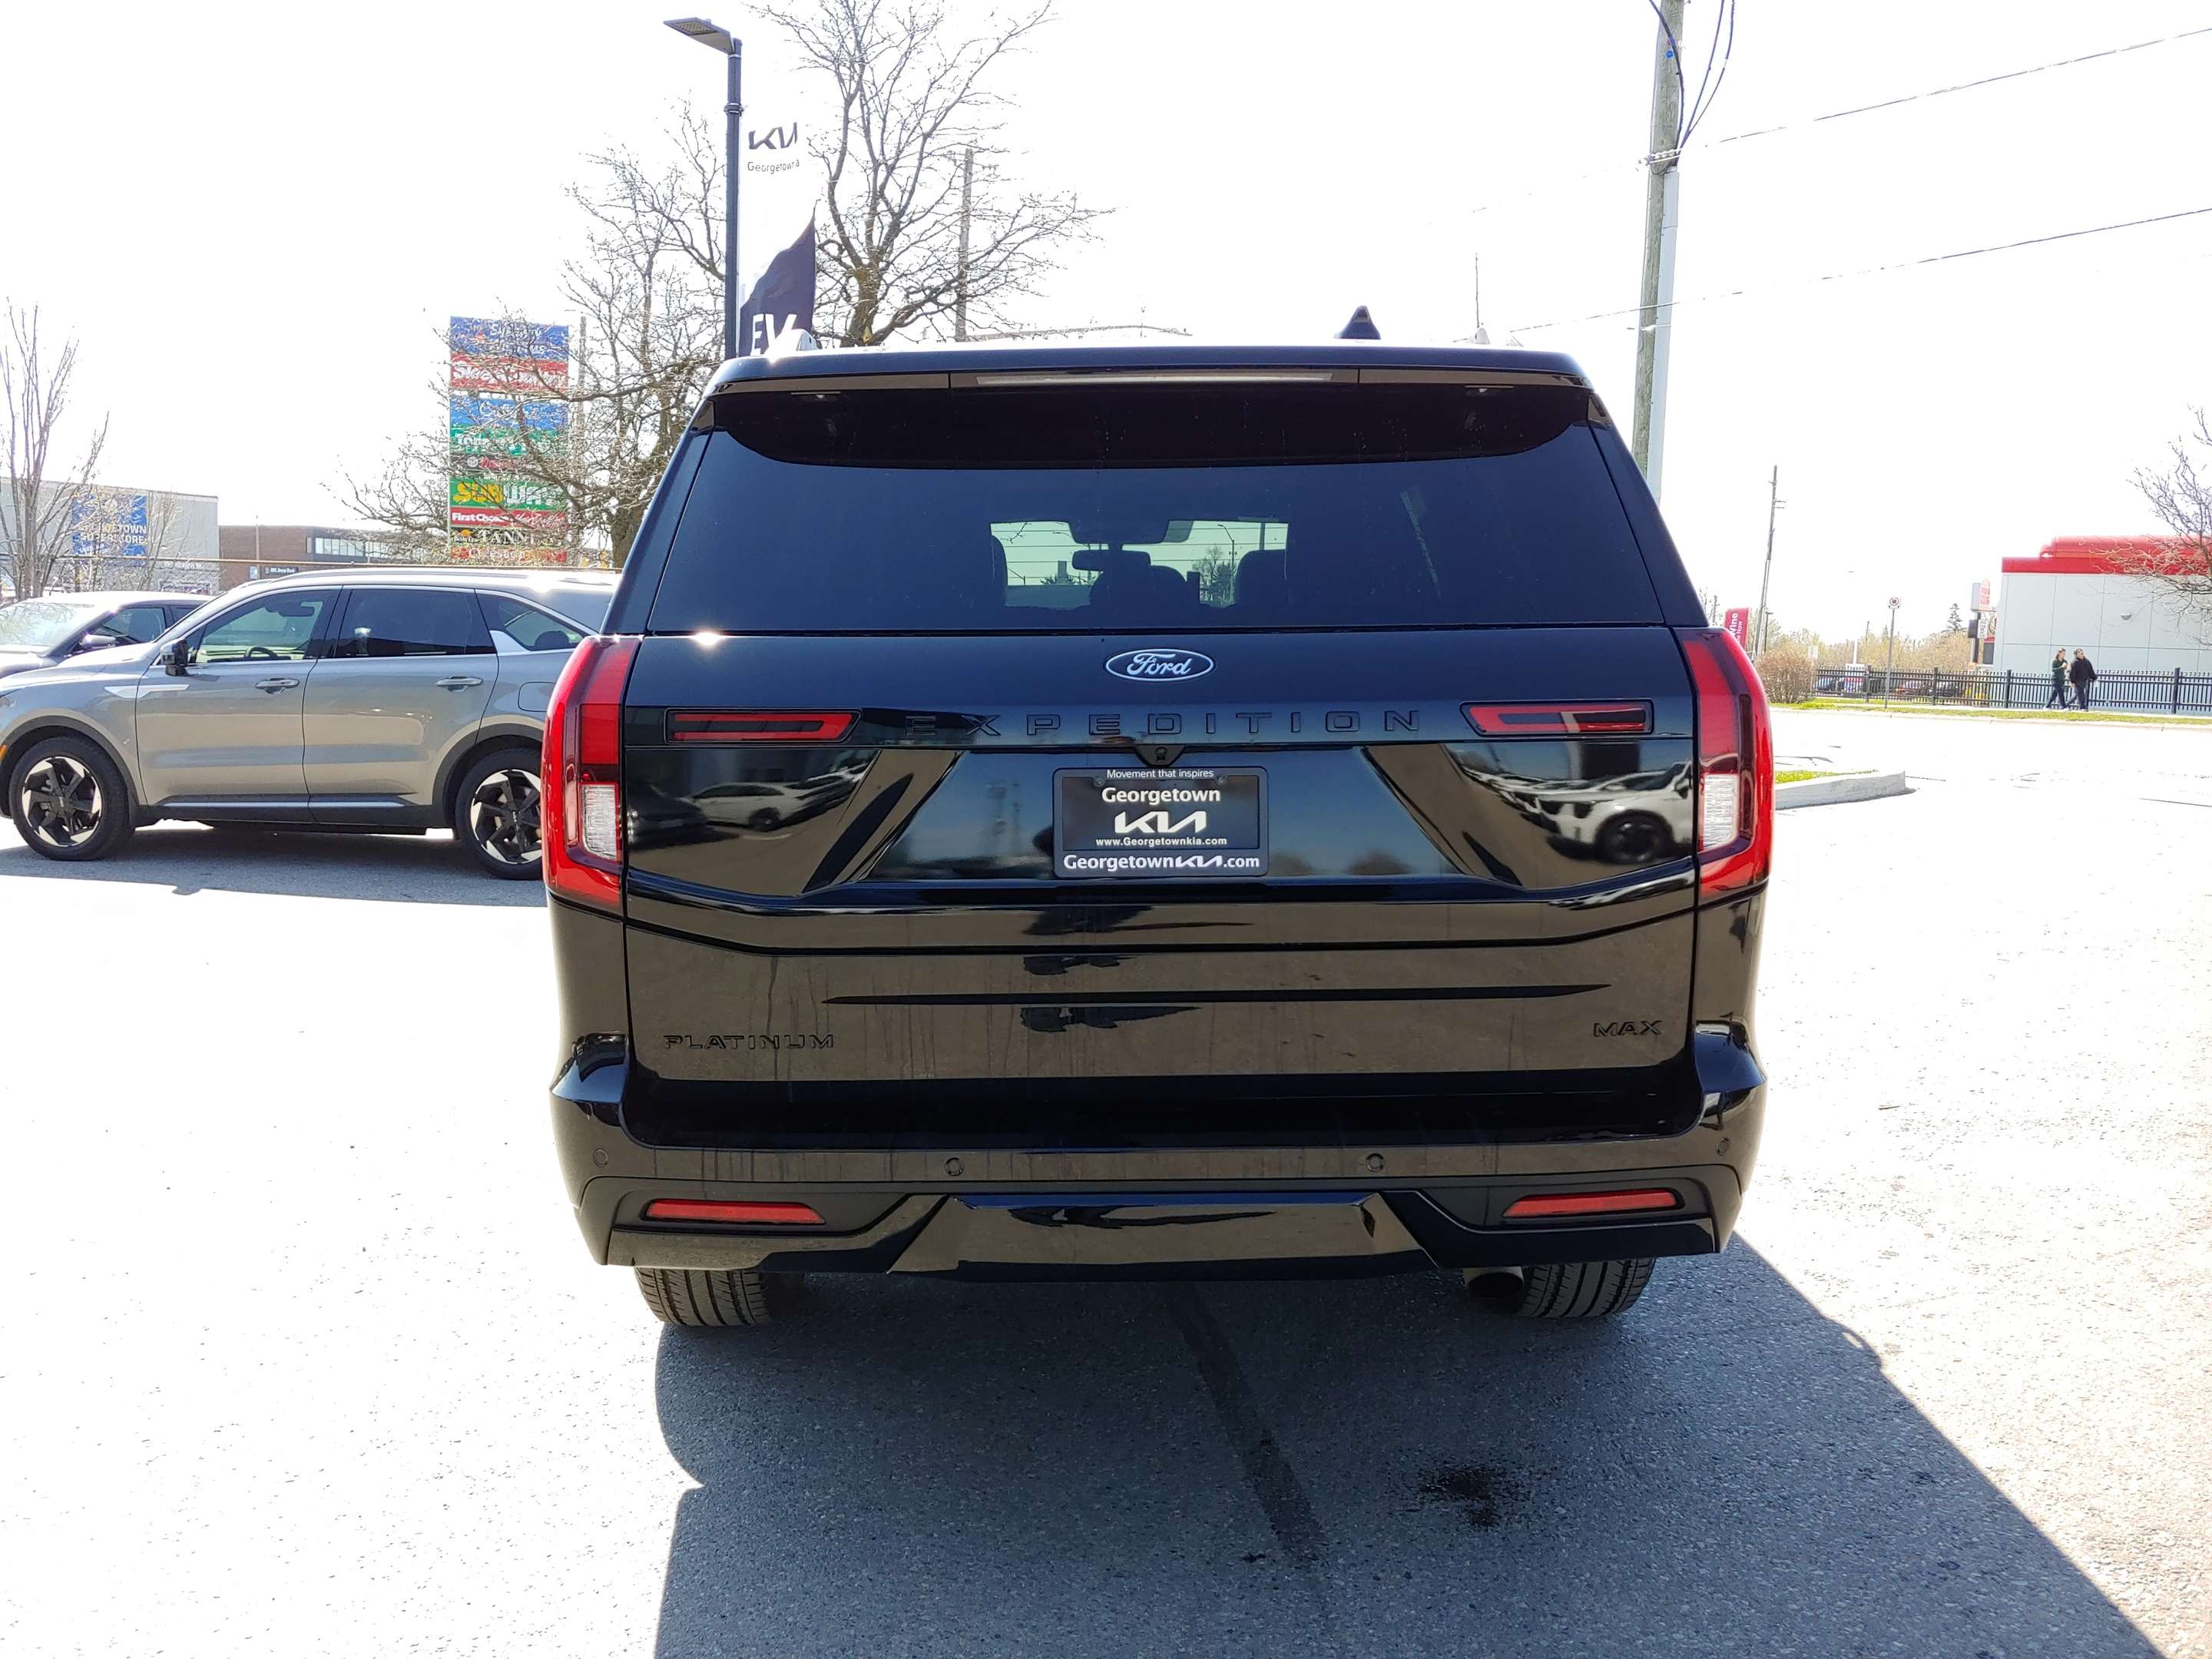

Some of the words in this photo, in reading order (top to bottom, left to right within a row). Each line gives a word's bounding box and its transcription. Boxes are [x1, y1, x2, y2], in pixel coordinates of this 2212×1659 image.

[750, 313, 797, 356] EV
[452, 512, 475, 522] First
[1127, 653, 1192, 675] Ford
[905, 710, 1419, 736] EXPEDITION
[1107, 770, 1155, 779] Movement
[1157, 770, 1176, 778] that
[1179, 769, 1214, 779] inspires
[1101, 786, 1220, 806] Georgetown
[1114, 810, 1207, 833] KIA
[1096, 837, 1227, 847] www.Georgetownkia.com
[1594, 1020, 1663, 1037] MAX
[663, 1035, 834, 1049] PLATINUM
